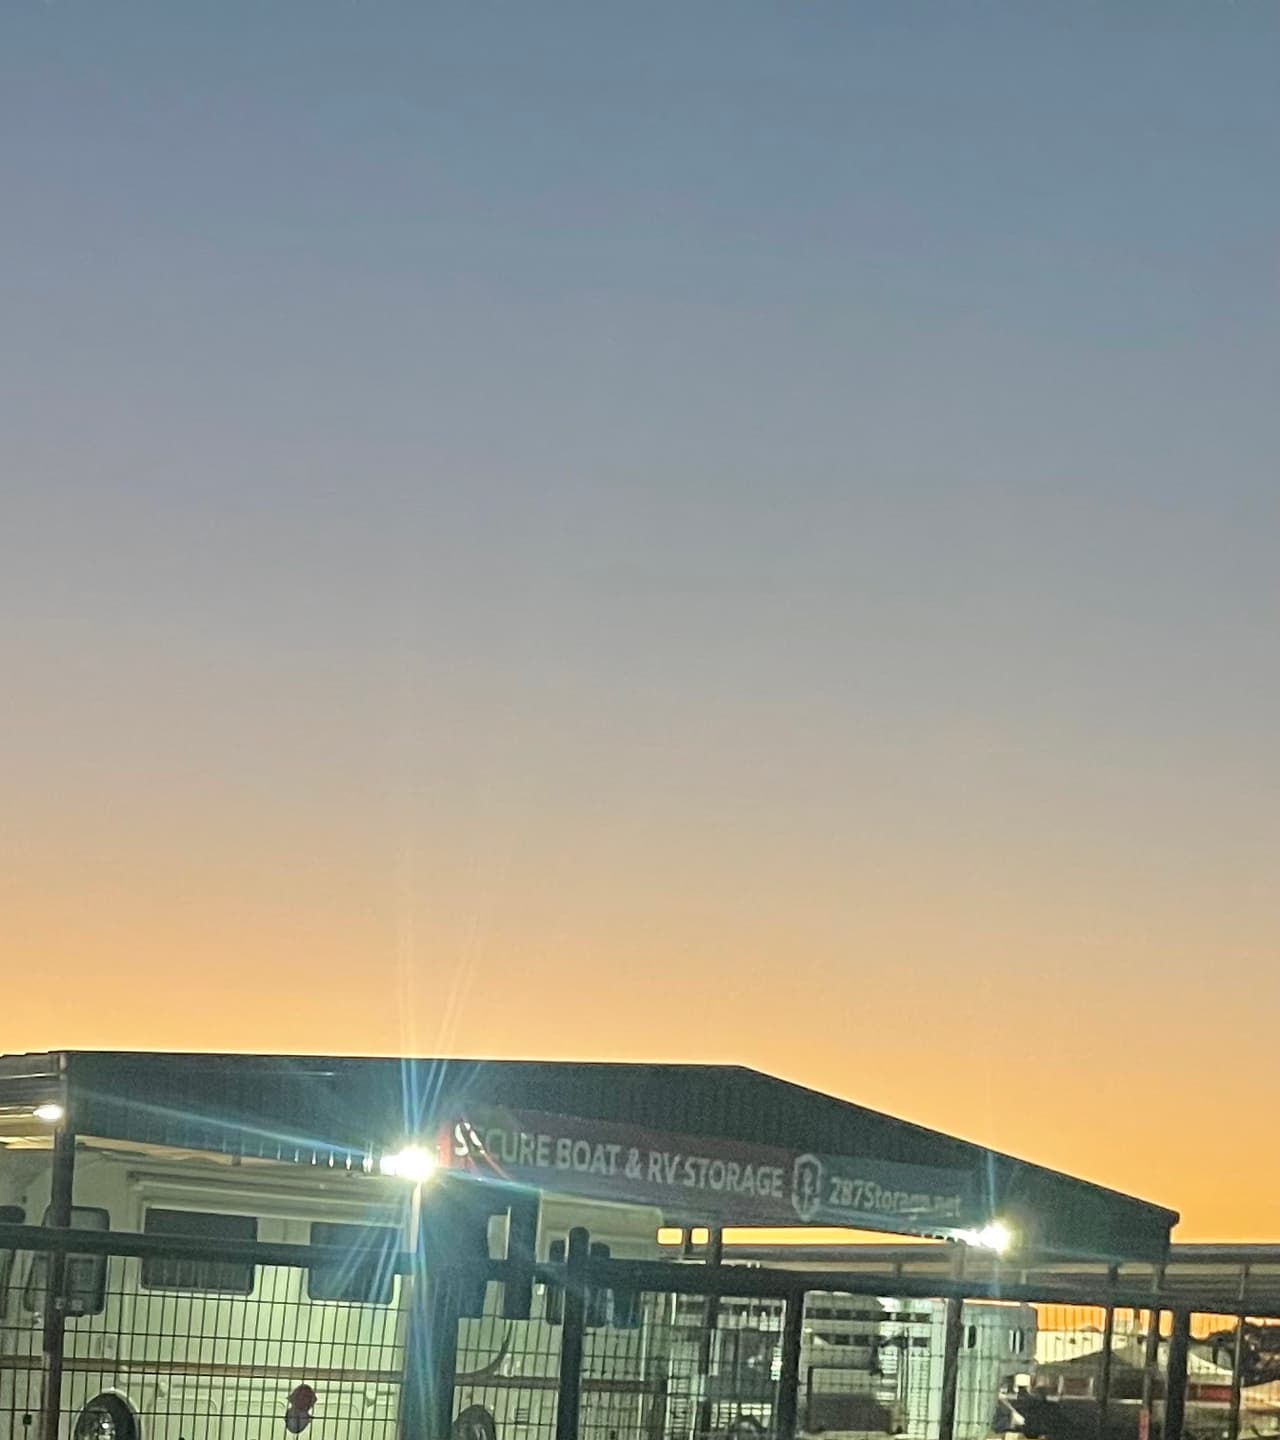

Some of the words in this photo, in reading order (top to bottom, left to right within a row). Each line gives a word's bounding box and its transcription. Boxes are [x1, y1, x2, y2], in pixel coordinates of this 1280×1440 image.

[454, 1122, 550, 1168] SCURE
[555, 1137, 622, 1175] BOAT
[624, 1149, 640, 1179] &
[647, 1150, 683, 1186] RV
[683, 1154, 785, 1199] STORAGE
